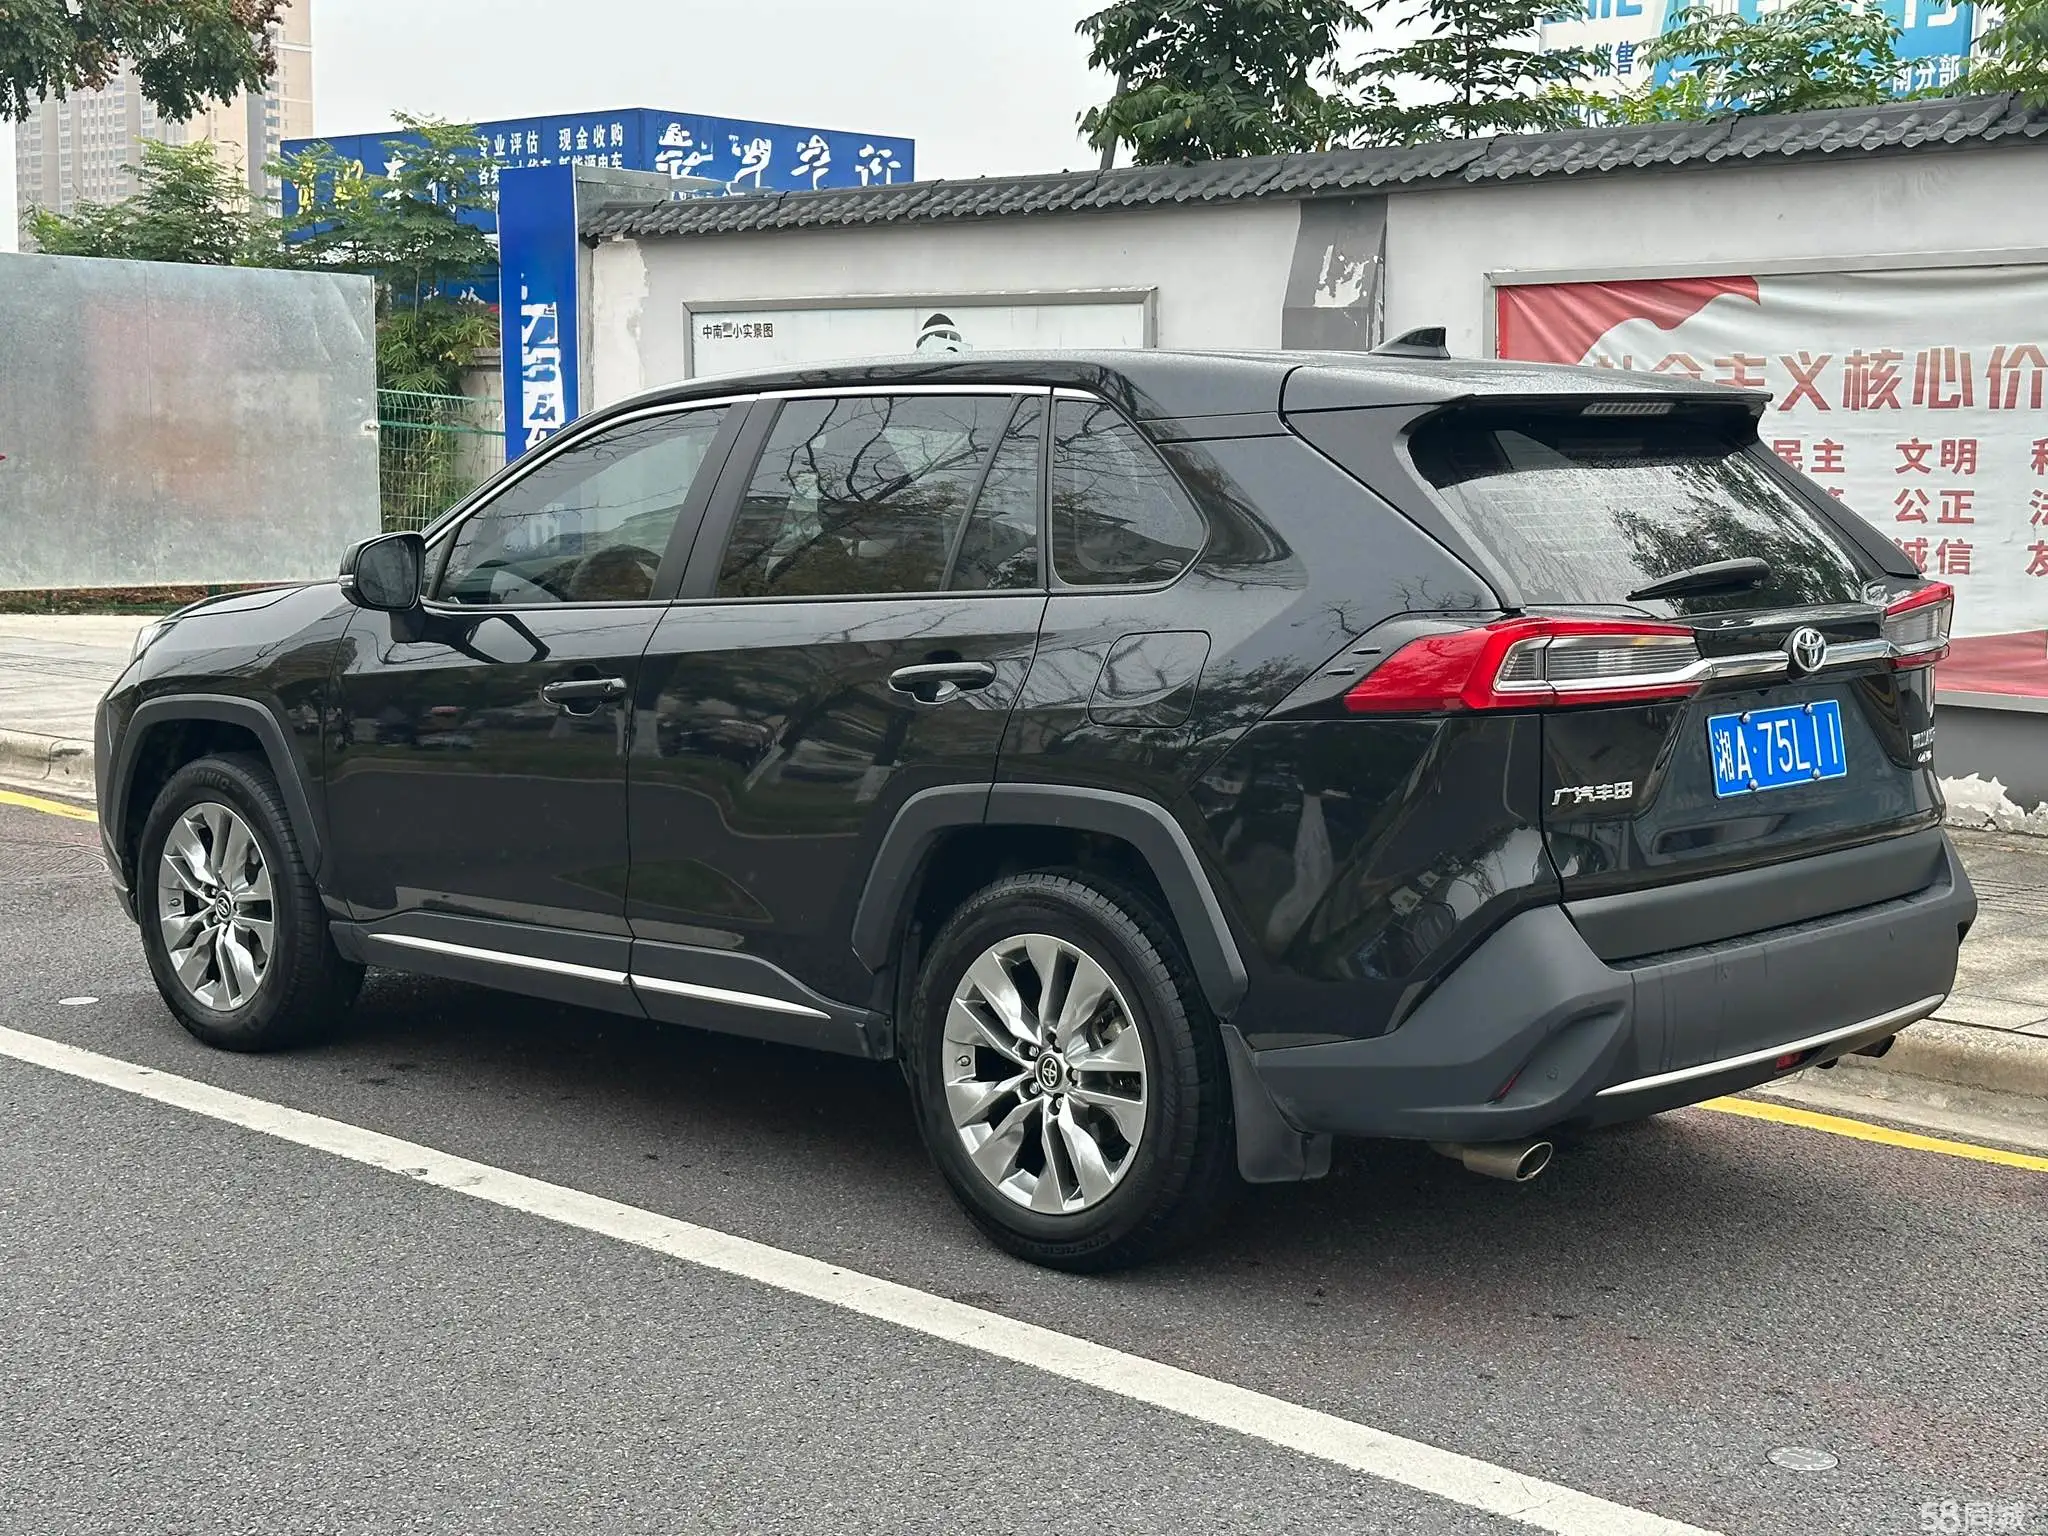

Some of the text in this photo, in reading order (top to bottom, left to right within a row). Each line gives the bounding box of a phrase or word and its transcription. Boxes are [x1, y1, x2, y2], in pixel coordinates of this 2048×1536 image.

[1544, 40, 1634, 81] 销售
[1874, 54, 1962, 93] 南分部
[478, 122, 623, 158] 专业评估 现金收购
[1773, 438, 1978, 475] 民主 文明
[1894, 488, 1975, 524] 公正
[1893, 537, 1974, 576] 诚信
[1551, 781, 1634, 806] 广汽丰田
